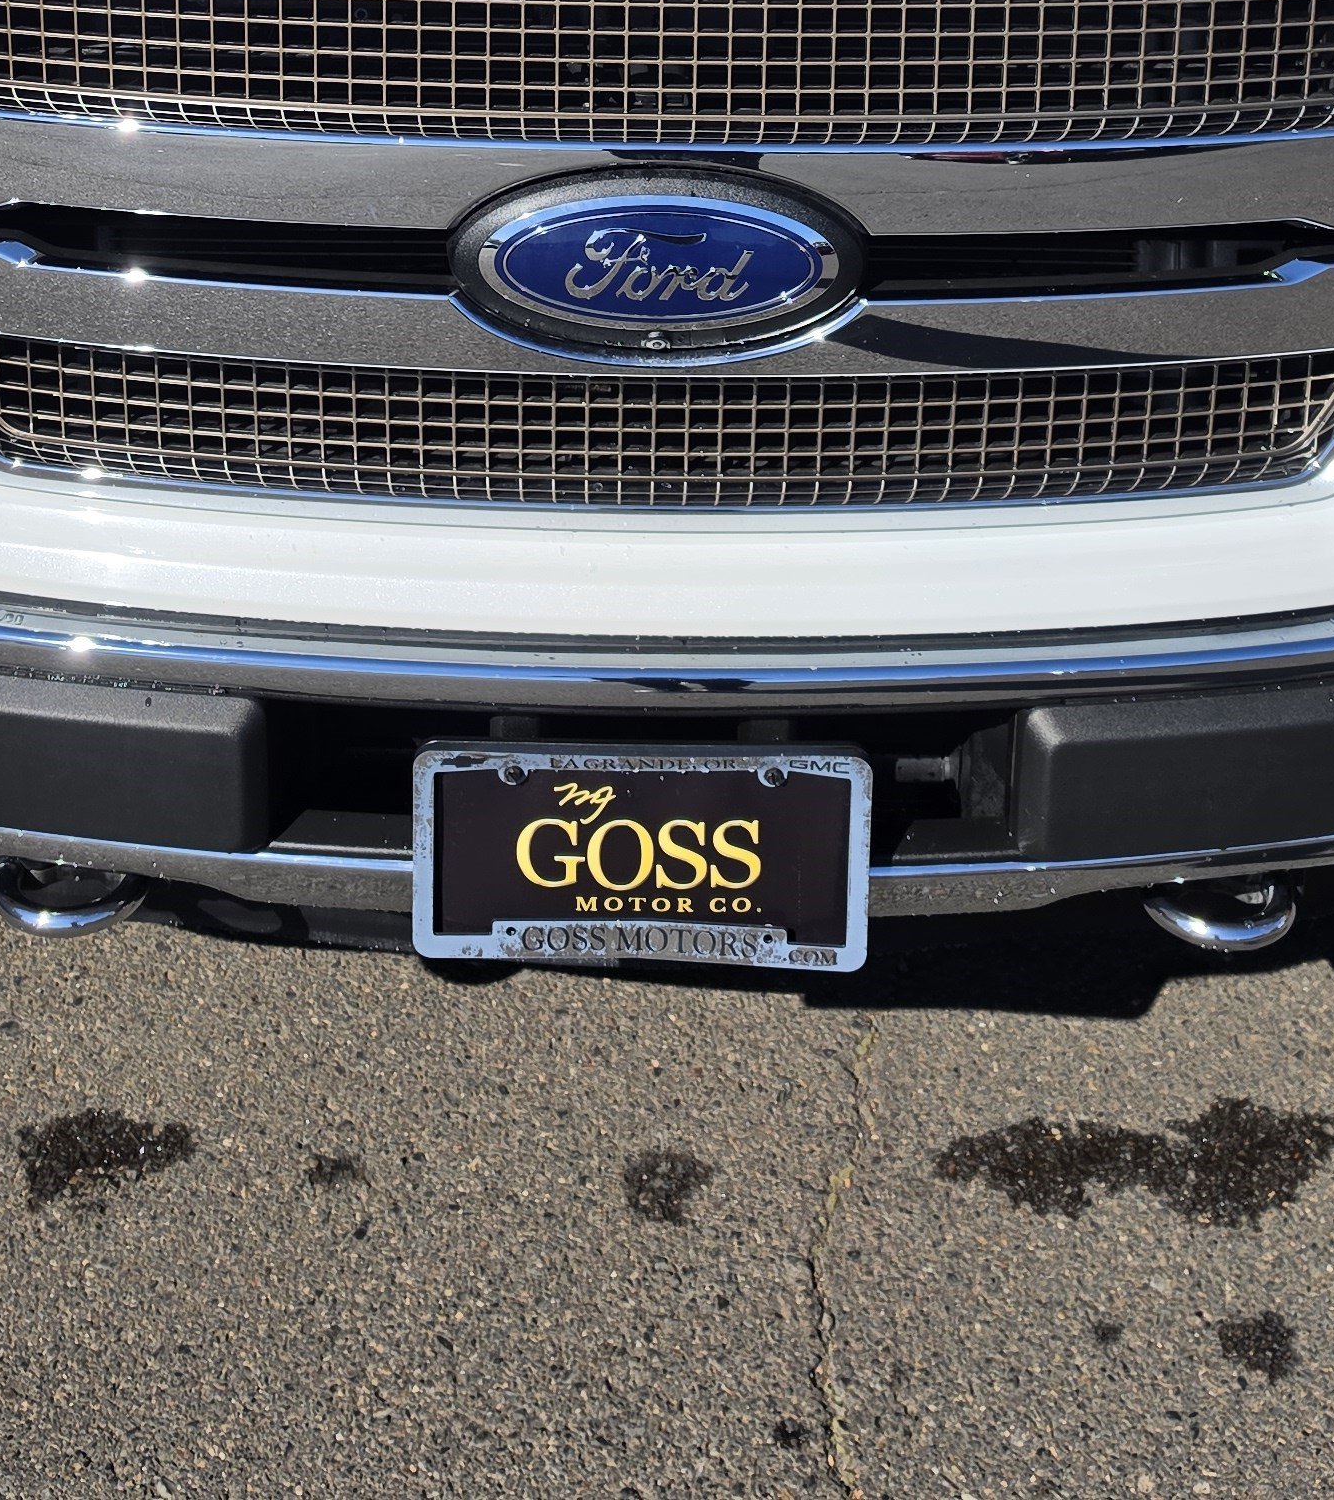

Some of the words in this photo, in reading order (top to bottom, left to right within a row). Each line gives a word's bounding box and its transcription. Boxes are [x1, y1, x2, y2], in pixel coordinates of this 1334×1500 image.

[564, 227, 755, 302] Ford
[703, 759, 737, 770] OR
[789, 759, 849, 774] GMC
[516, 817, 762, 892] GOSS
[575, 896, 695, 913] MOTOR
[709, 897, 762, 913] CO.
[521, 926, 607, 952] GOSS
[616, 926, 759, 959] MOTORS
